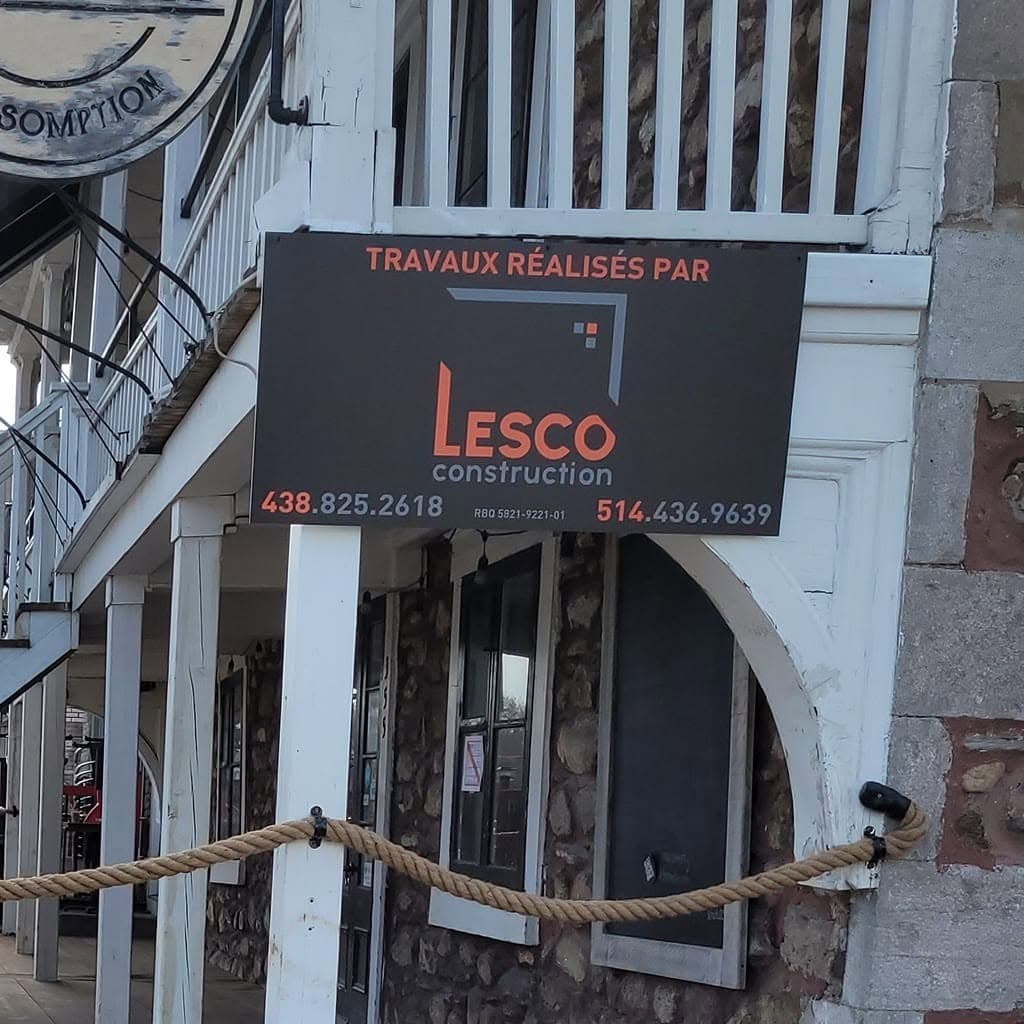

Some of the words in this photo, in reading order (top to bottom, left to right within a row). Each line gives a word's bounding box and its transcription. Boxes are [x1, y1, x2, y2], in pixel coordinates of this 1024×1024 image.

[367, 246, 499, 275] TRAVAUX
[508, 247, 644, 281] RÉALISÉS
[653, 256, 711, 282] PAR
[432, 360, 617, 462] LESCO
[432, 459, 613, 487] construction
[260, 491, 444, 518] 438.825.2618
[474, 508, 495, 518] RBQ
[497, 508, 565, 520] 5821-9221-01
[596, 498, 772, 526] 514.436.9639
